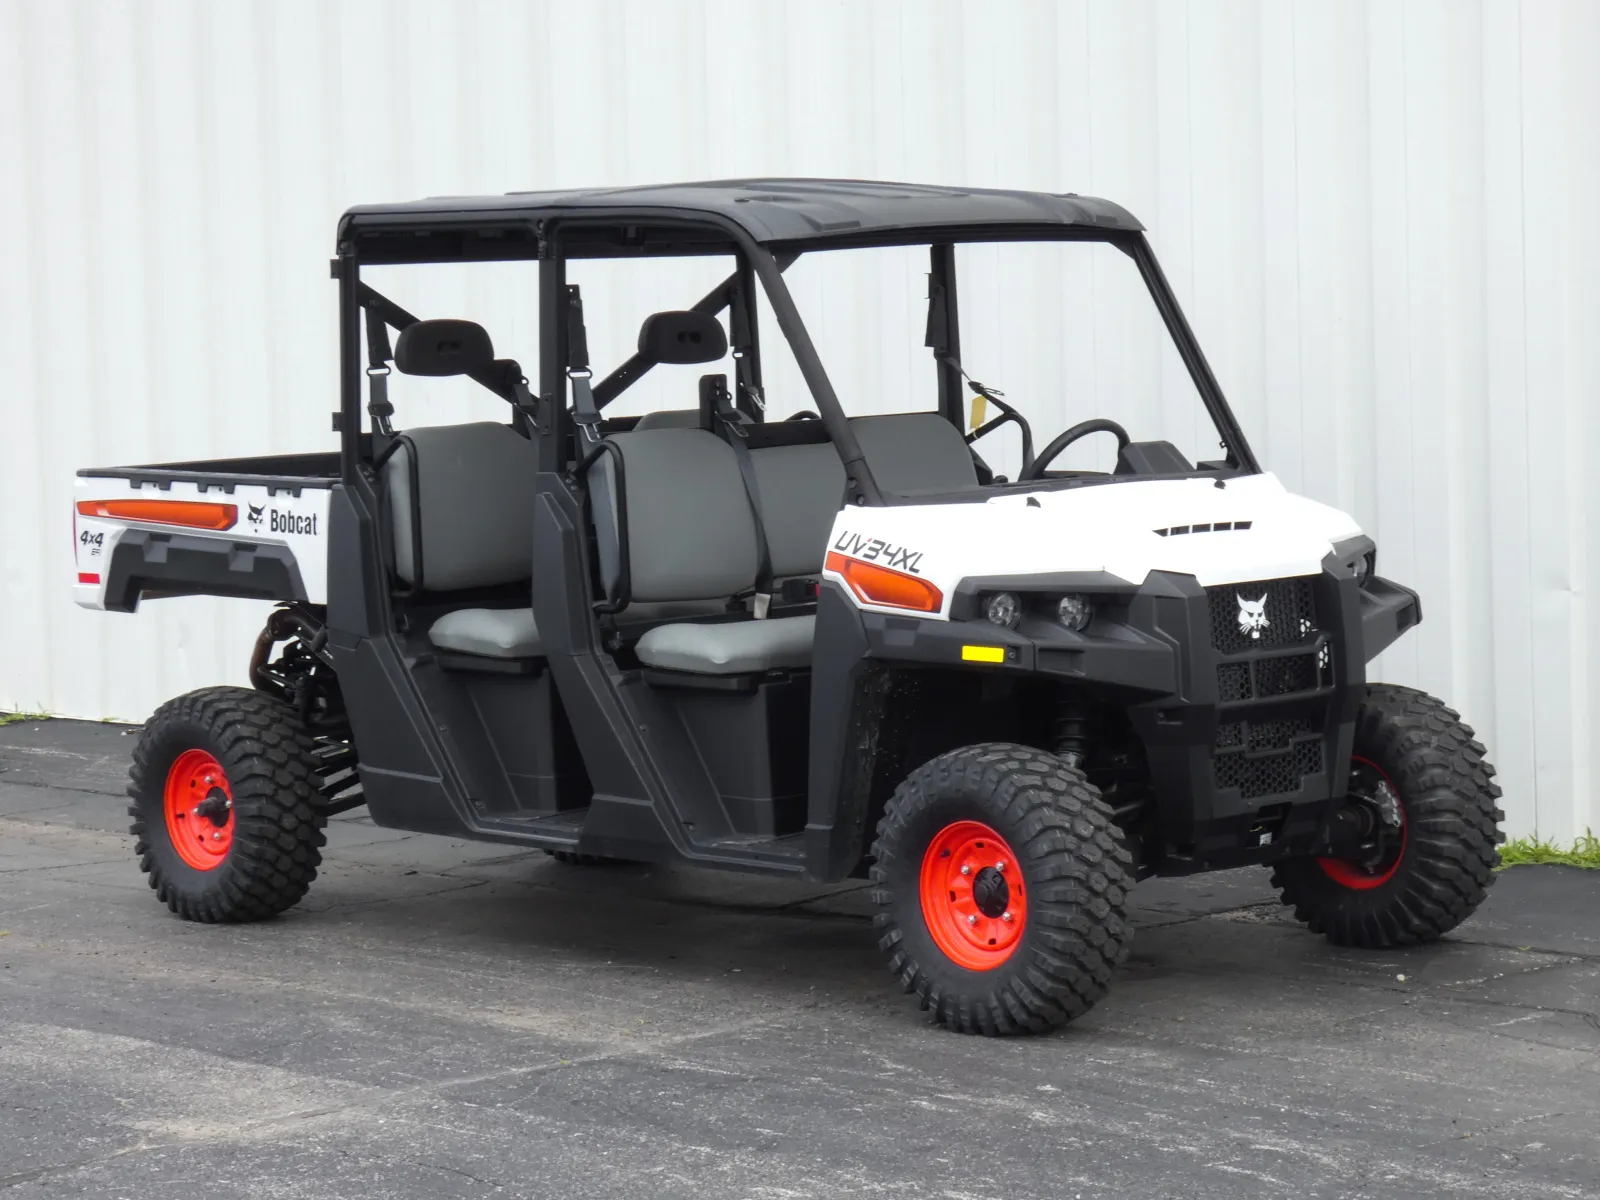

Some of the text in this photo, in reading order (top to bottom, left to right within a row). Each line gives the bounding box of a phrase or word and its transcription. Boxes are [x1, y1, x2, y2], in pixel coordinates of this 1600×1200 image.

[270, 508, 317, 536] Bobcat
[80, 530, 104, 547] 4x4
[834, 530, 924, 574] UV34XL
